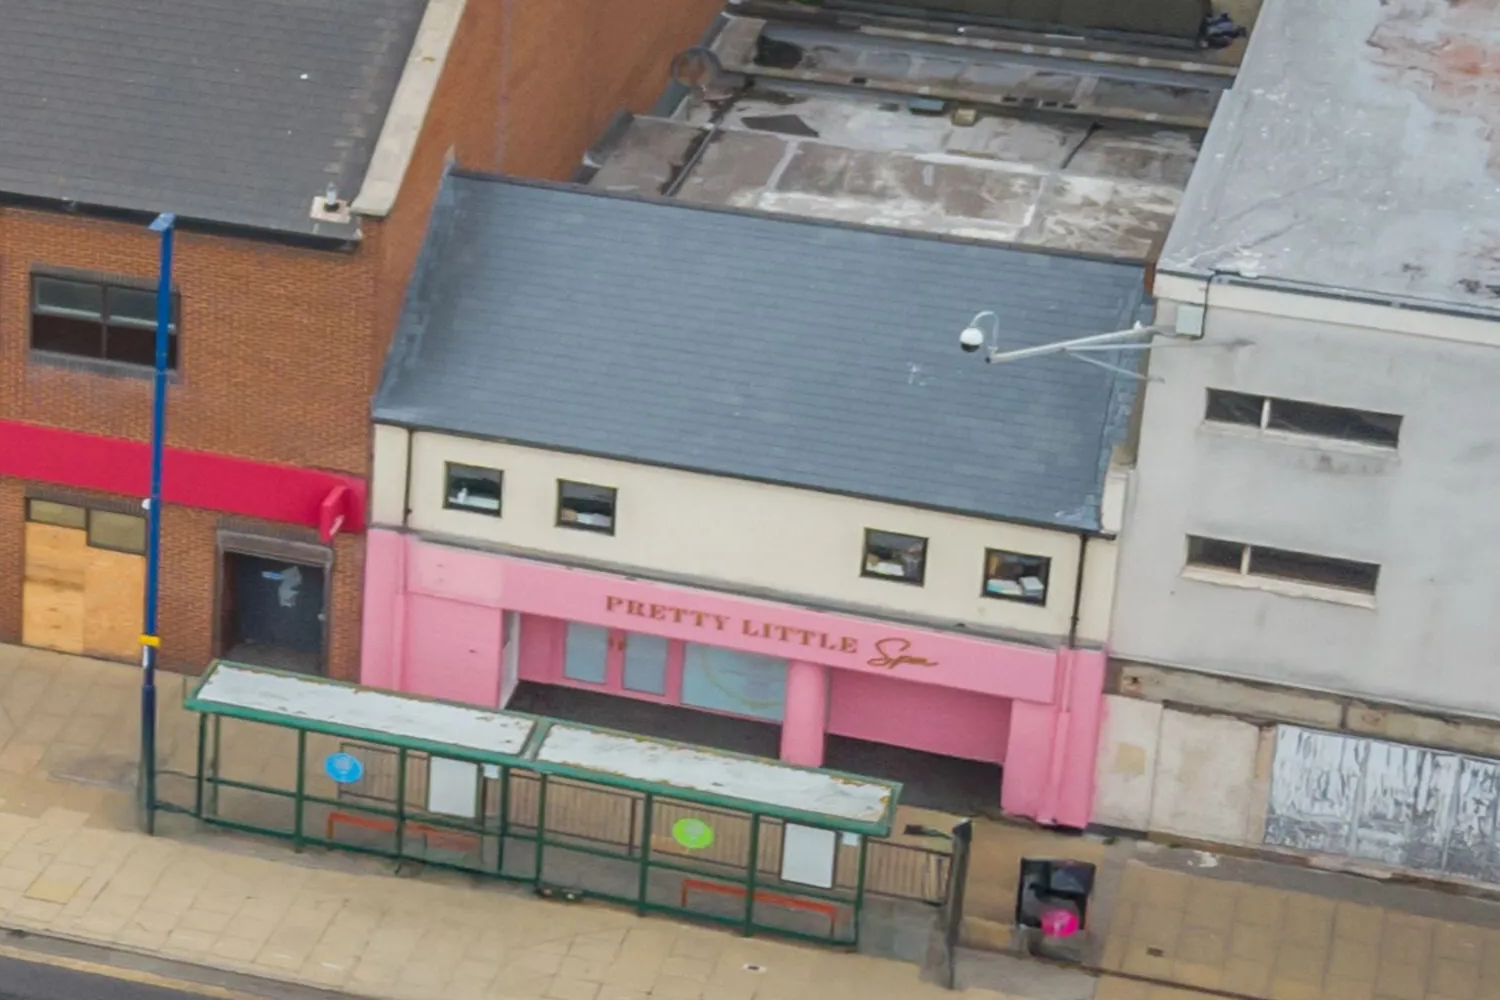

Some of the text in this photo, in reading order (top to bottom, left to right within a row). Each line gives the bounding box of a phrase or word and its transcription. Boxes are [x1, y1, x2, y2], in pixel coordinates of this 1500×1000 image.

[605, 595, 940, 670] PRETTY LITTLE Spa
